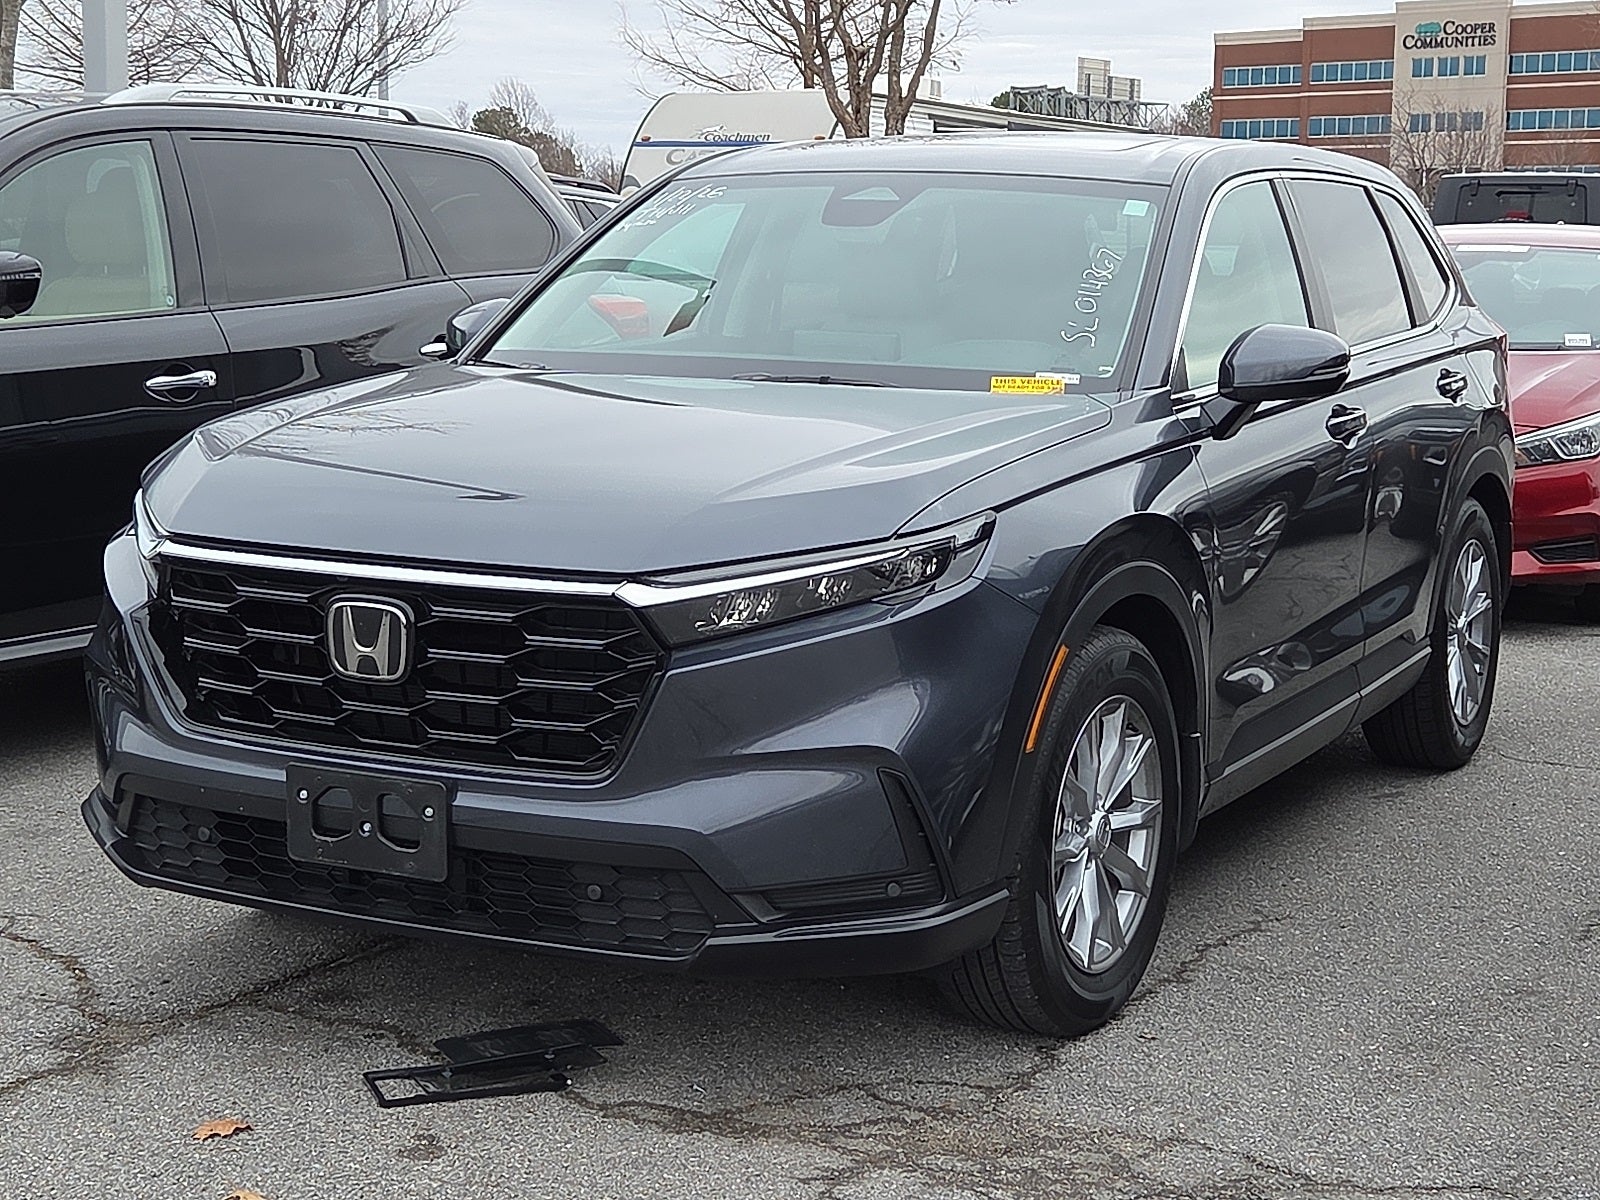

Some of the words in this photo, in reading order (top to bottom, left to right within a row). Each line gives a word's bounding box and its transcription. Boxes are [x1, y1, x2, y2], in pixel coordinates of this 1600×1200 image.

[1443, 20, 1496, 35] COOPER
[1402, 34, 1496, 49] COMMUNITIES
[703, 132, 770, 142] Coachmen
